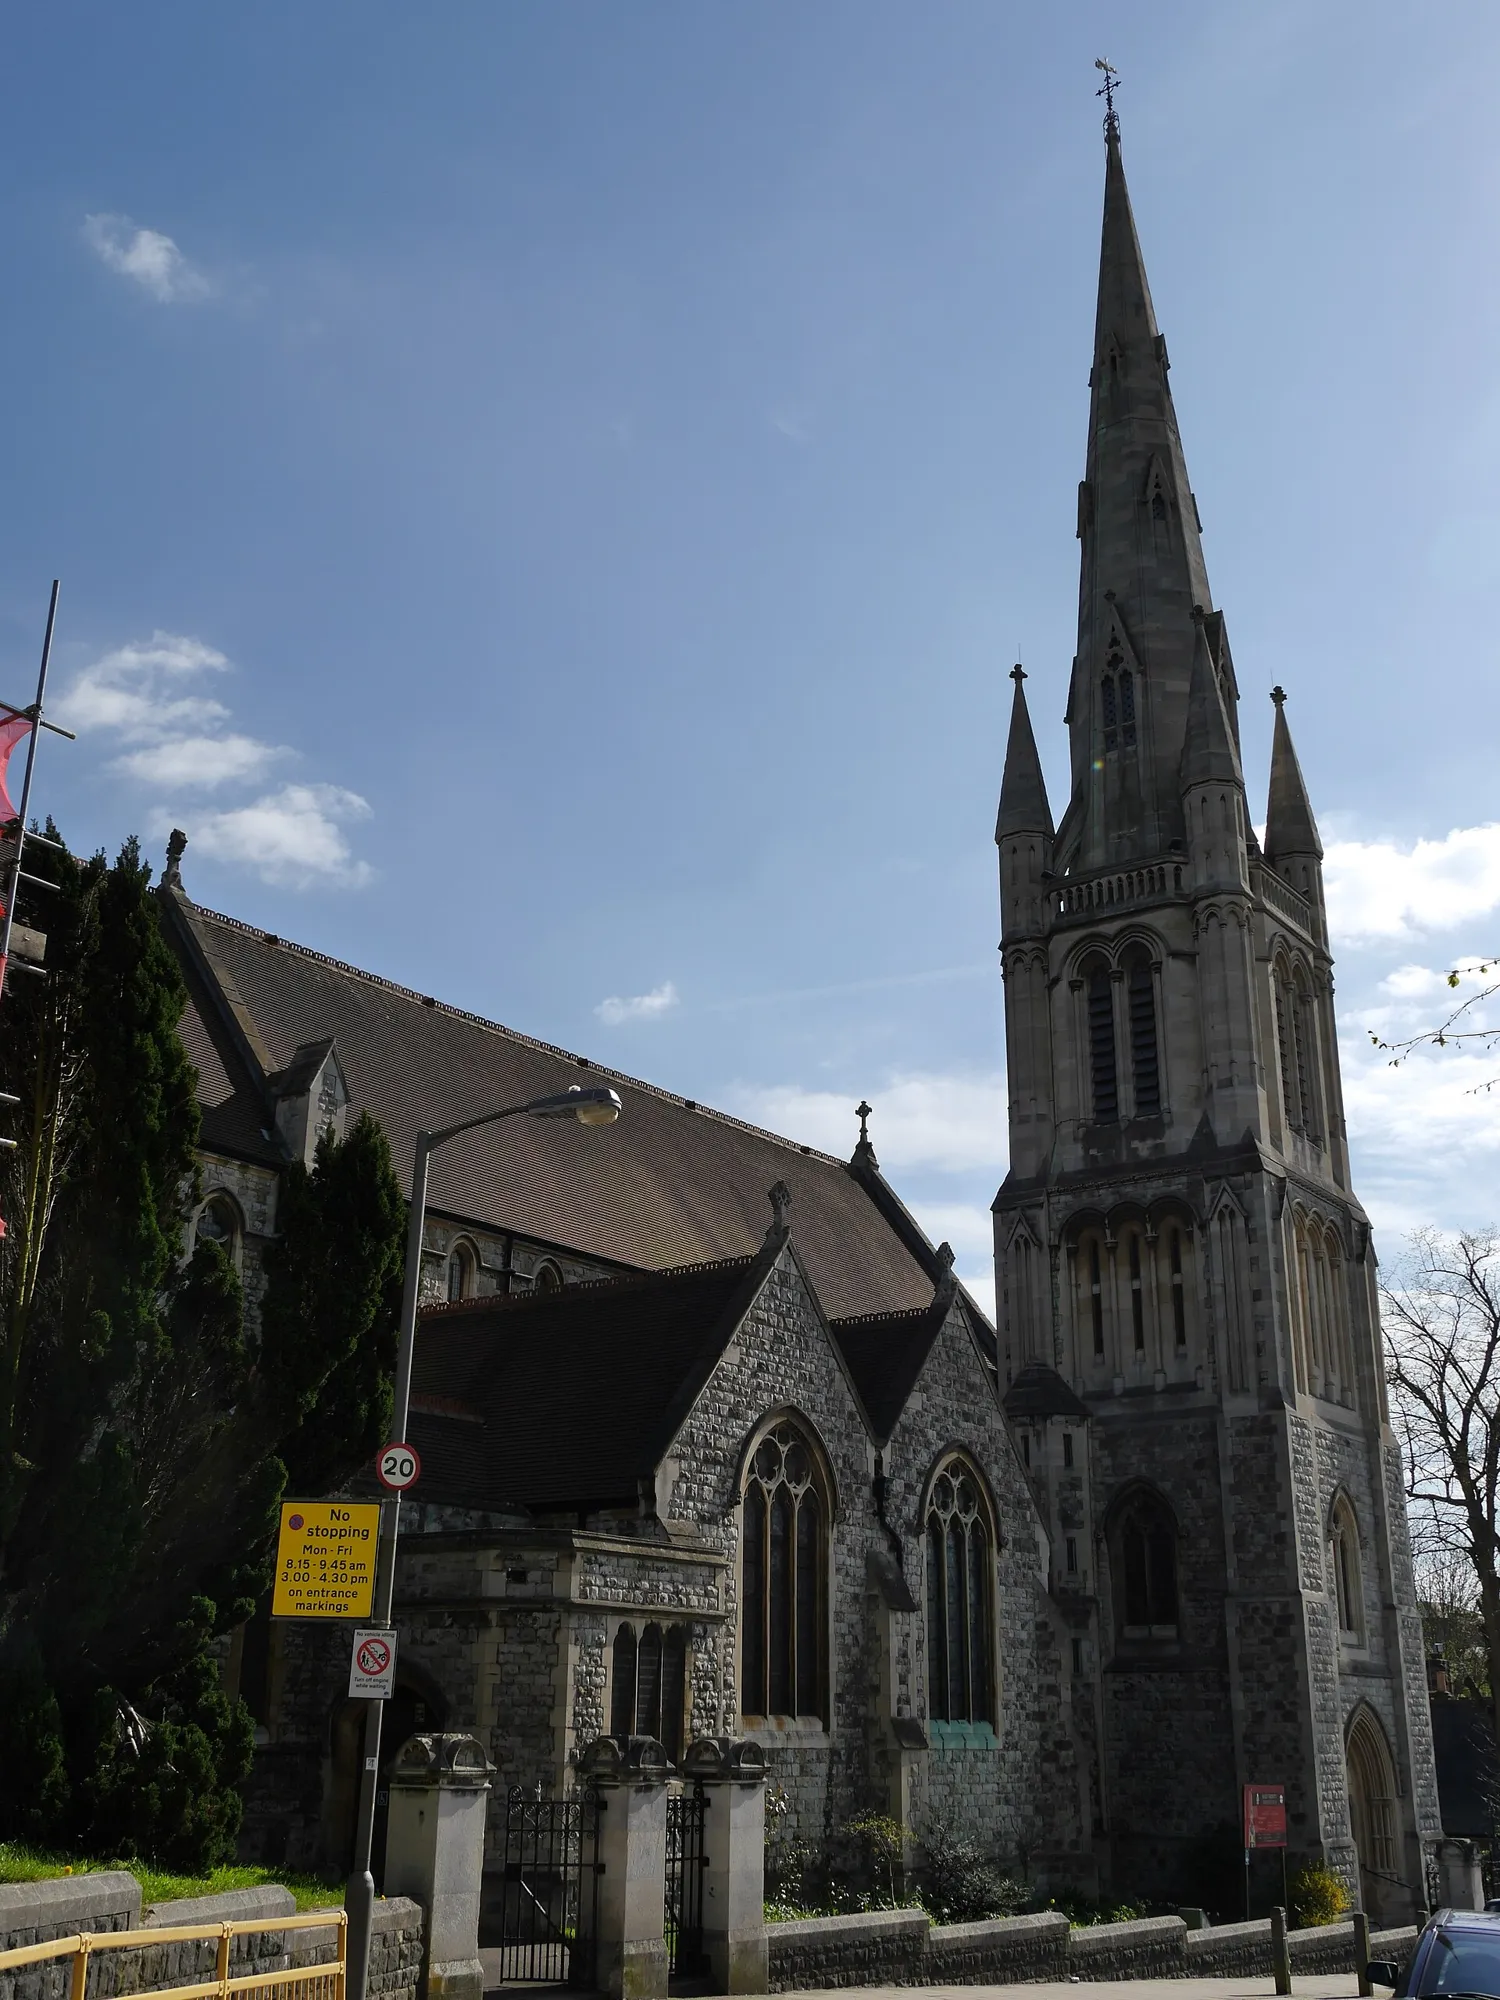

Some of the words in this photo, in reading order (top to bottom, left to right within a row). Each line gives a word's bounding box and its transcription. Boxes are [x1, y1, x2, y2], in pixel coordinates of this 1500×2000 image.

[384, 1456, 414, 1478] 20
[329, 1509, 350, 1521] No
[307, 1525, 369, 1540] stopping
[302, 1545, 327, 1555] Mon
[337, 1546, 353, 1556] Fri
[286, 1559, 310, 1570] 8.15
[319, 1560, 346, 1570] 9.45
[349, 1562, 366, 1570] am
[281, 1572, 310, 1582] 3.00
[319, 1573, 348, 1583] 4.30
[350, 1575, 368, 1585] pm
[288, 1589, 302, 1597] on
[306, 1588, 358, 1598] entrance
[295, 1601, 349, 1613] markings
